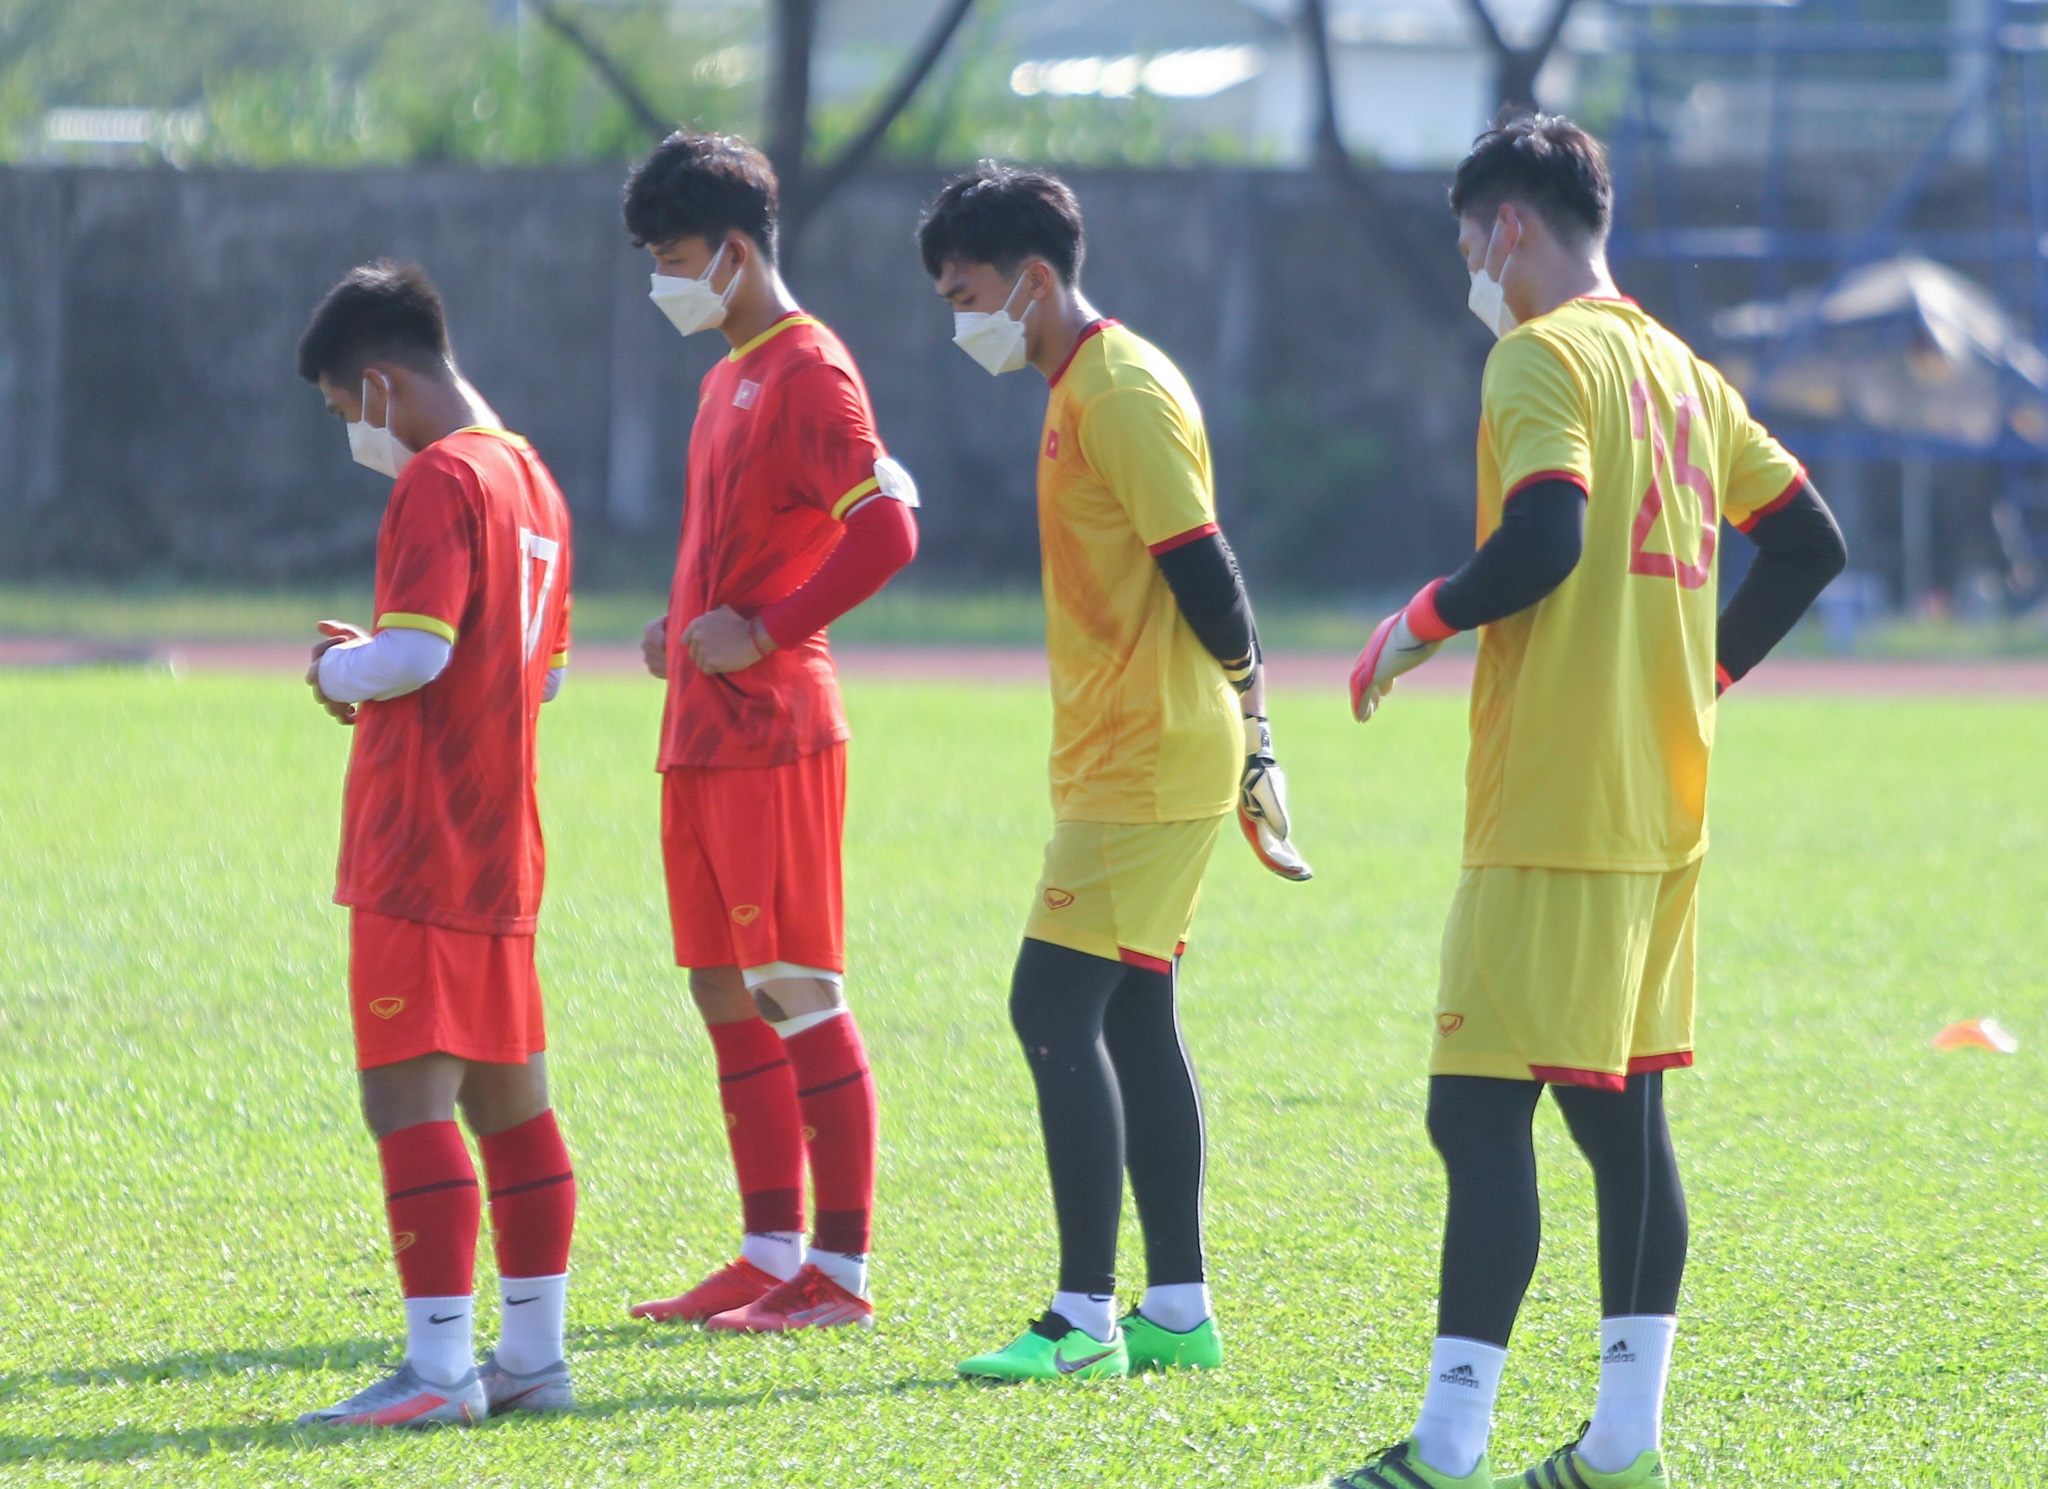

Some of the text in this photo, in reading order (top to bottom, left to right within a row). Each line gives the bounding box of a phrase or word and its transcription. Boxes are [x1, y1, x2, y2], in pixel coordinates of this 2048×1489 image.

[1628, 377, 1716, 590] 25
[519, 526, 559, 668] 17
[1439, 1372, 1479, 1389] adidas
